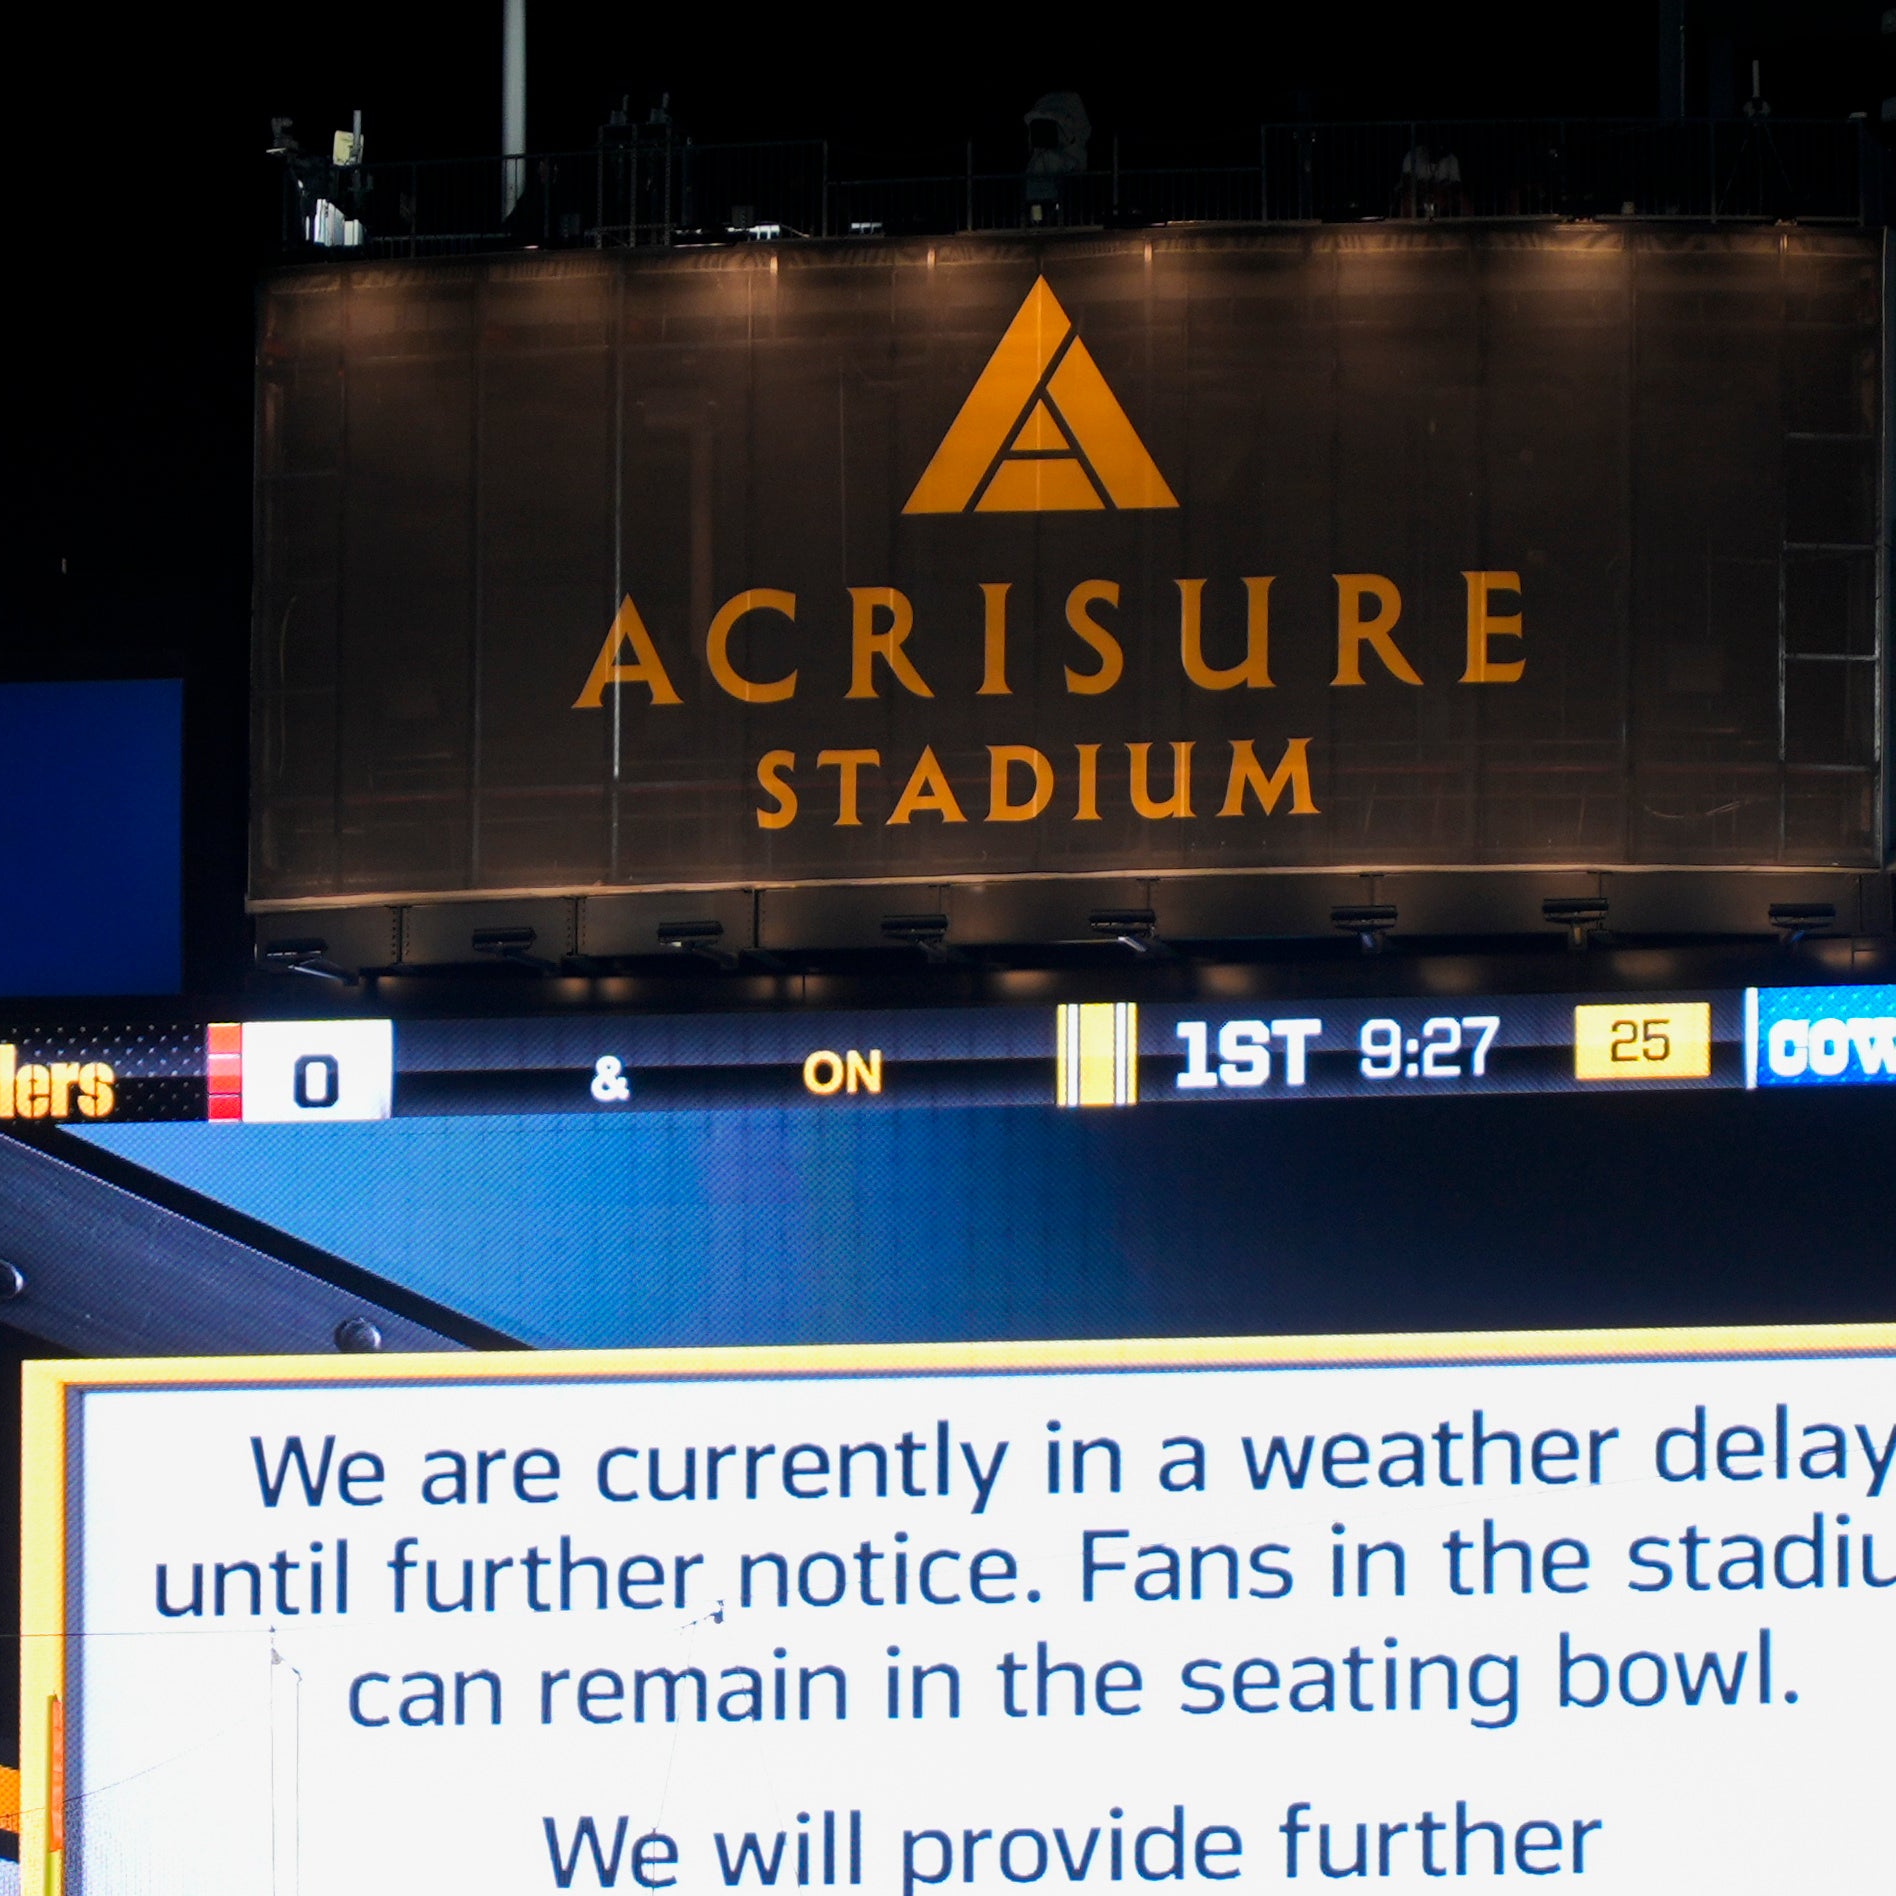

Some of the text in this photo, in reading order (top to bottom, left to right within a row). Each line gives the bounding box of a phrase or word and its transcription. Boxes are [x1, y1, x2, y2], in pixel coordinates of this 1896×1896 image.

[572, 570, 1526, 710] ACRISURE
[755, 736, 1321, 831] STADIUM
[294, 1054, 338, 1108] 0
[591, 1050, 882, 1102] & ON
[1175, 1017, 1500, 1089] 1ST 9:27
[1608, 1018, 1672, 1065] 25
[251, 1434, 386, 1508] We
[420, 1443, 562, 1505] are
[596, 1420, 1010, 1515] currently
[1047, 1420, 1120, 1493] in
[1158, 1436, 1206, 1493] a
[1240, 1410, 1618, 1490] weather
[154, 1538, 348, 1617] until
[387, 1534, 702, 1613] further
[741, 1532, 1040, 1608] notice.
[1082, 1529, 1292, 1602] Fans
[1331, 1523, 1406, 1597] in
[1443, 1519, 1590, 1595] the
[348, 1628, 1799, 1729] can remain in the seating bowl.
[542, 1815, 678, 1889] We
[714, 1810, 861, 1886] will
[1279, 1800, 1602, 1878] further
